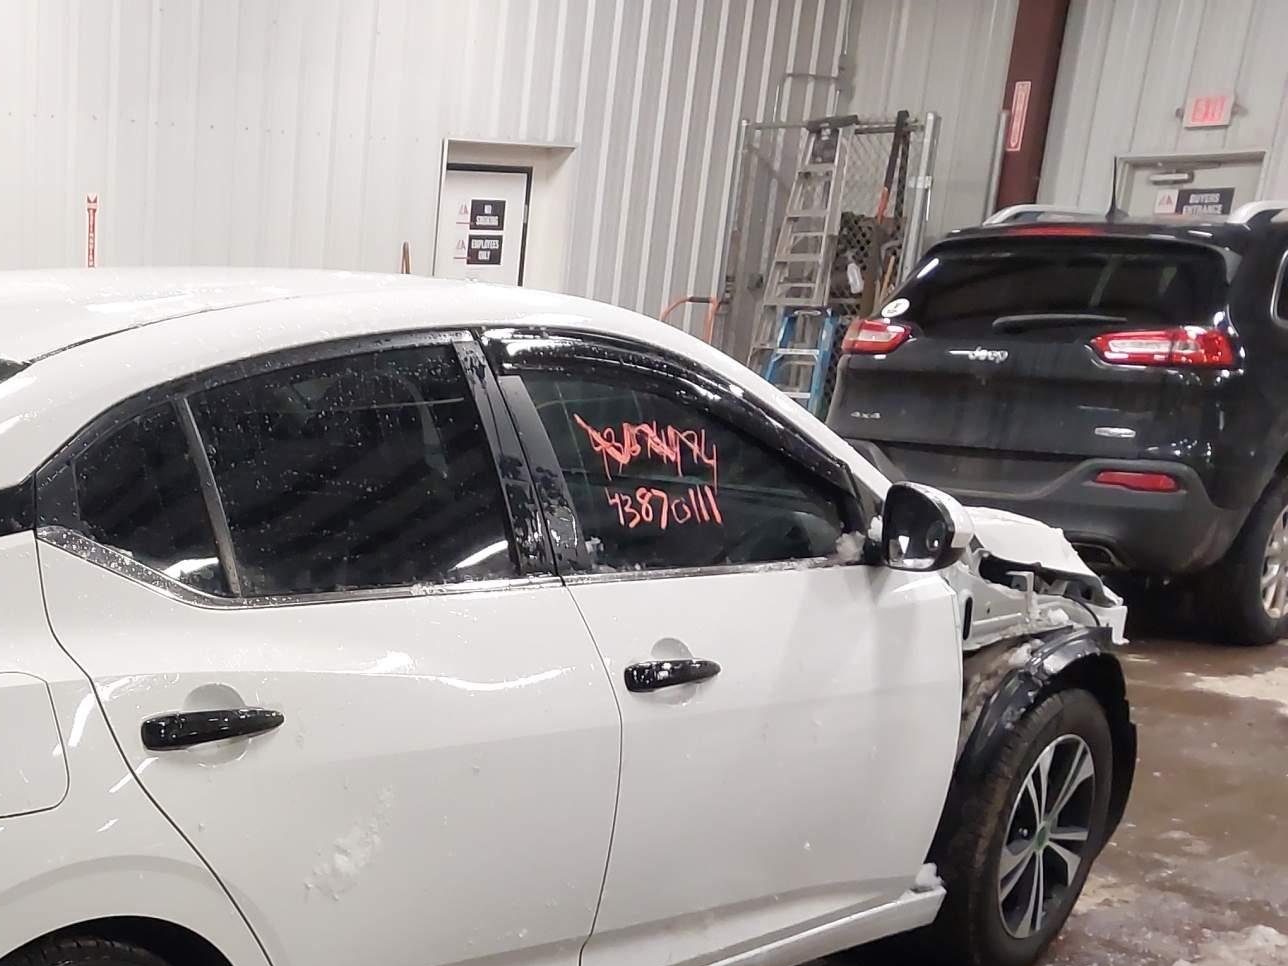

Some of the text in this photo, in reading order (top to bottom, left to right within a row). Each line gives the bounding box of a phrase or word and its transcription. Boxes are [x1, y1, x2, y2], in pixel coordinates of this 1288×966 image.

[1189, 193, 1220, 204] BUYERS
[968, 346, 1008, 363] Jeep
[605, 484, 724, 530] 43870111
